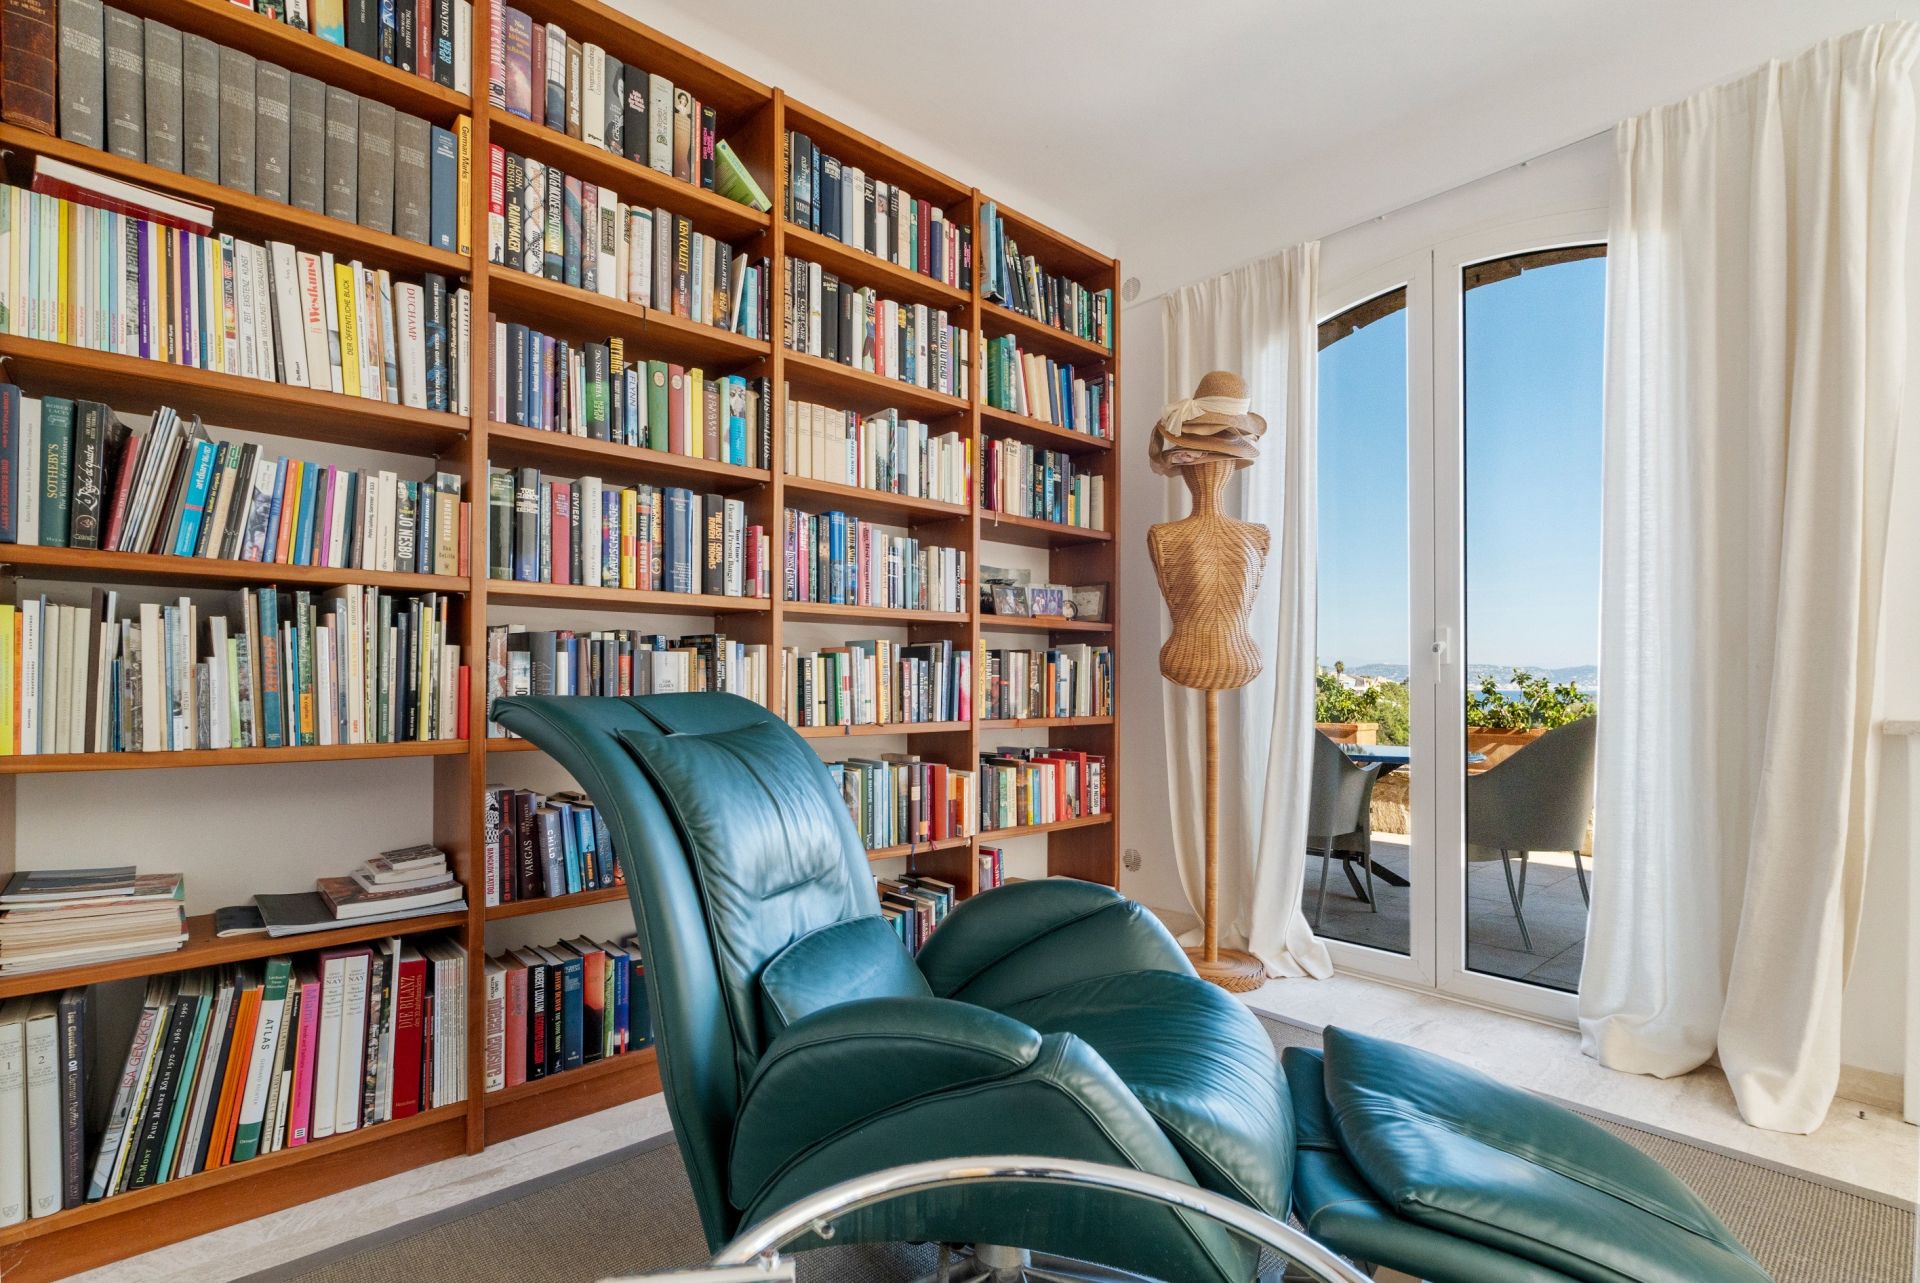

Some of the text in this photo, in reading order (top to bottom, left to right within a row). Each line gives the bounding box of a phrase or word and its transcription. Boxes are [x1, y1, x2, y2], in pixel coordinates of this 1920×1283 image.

[406, 287, 416, 341] DUCHAMP
[610, 338, 623, 375] OUTRAGE
[47, 444, 58, 498] SOTHEBY'S
[524, 840, 533, 877] VARGAS
[547, 829, 555, 859] CHILD
[534, 967, 544, 988] ROBERT
[398, 975, 416, 1029] DIE BILANZ
[534, 989, 544, 1013] LUDLUM
[129, 1011, 154, 1066] GENZKEN
[261, 1019, 275, 1050] ATLAS
